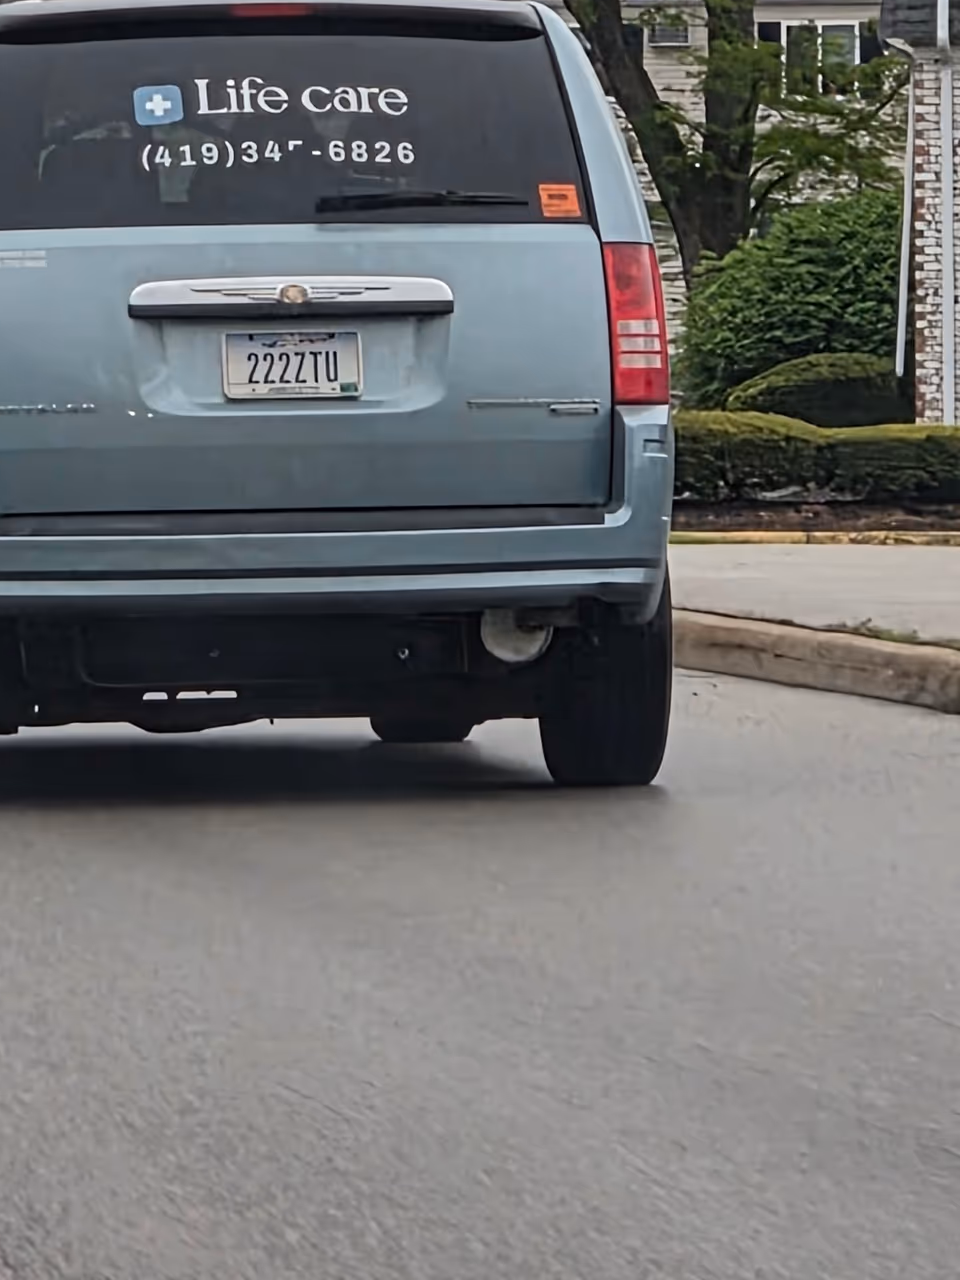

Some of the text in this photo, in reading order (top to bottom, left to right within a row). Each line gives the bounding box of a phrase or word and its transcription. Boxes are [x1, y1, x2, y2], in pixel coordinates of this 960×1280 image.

[193, 76, 409, 116] Life care
[246, 350, 339, 385] 222ZTU
